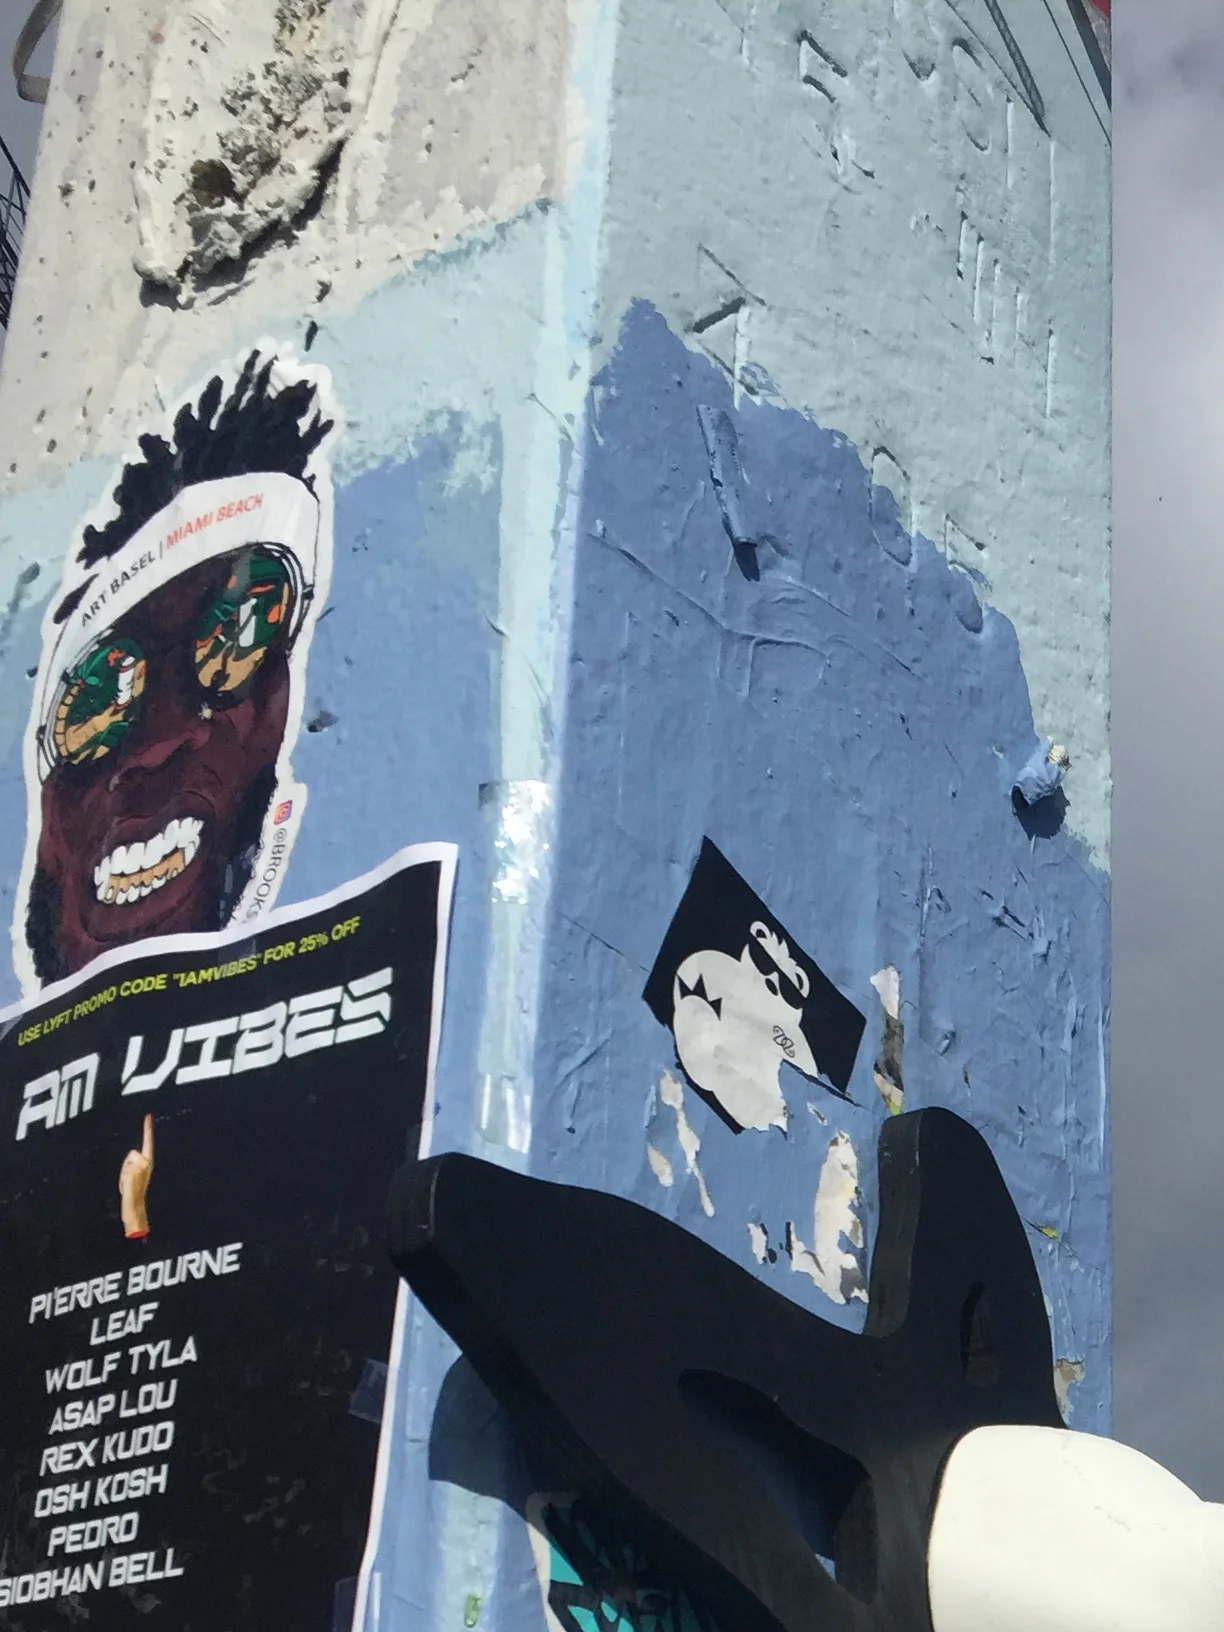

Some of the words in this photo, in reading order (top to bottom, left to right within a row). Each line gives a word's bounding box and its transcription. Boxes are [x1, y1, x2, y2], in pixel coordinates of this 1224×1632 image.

[82, 590, 107, 627] ART
[110, 551, 156, 595] BASEL
[166, 512, 213, 549] MIAMI
[216, 493, 264, 522] BEACH
[243, 828, 287, 922] @BROOKS
[18, 1024, 42, 1047] USE
[43, 1009, 73, 1034] LYFT
[73, 986, 117, 1020] PROMO
[120, 973, 168, 997] CODE
[263, 942, 295, 964] FOR
[298, 932, 328, 954] 25%
[331, 916, 361, 940] OFF
[15, 1052, 99, 1141] AM
[120, 966, 393, 1096] VIBES
[127, 1242, 243, 1296] BOURNE
[90, 1302, 160, 1346] LEAF
[45, 1352, 121, 1394] WOLF
[128, 1336, 198, 1375] TYLA
[49, 1393, 116, 1435] ASAP
[119, 1379, 178, 1418] LOU
[39, 1438, 99, 1477] REX
[101, 1421, 175, 1464] KUDO
[34, 1480, 90, 1518] OSH
[94, 1464, 169, 1506] KOSH
[47, 1511, 140, 1556] PEDRO
[0, 1560, 104, 1607] SIOBHAN
[108, 1548, 185, 1587] BELL
